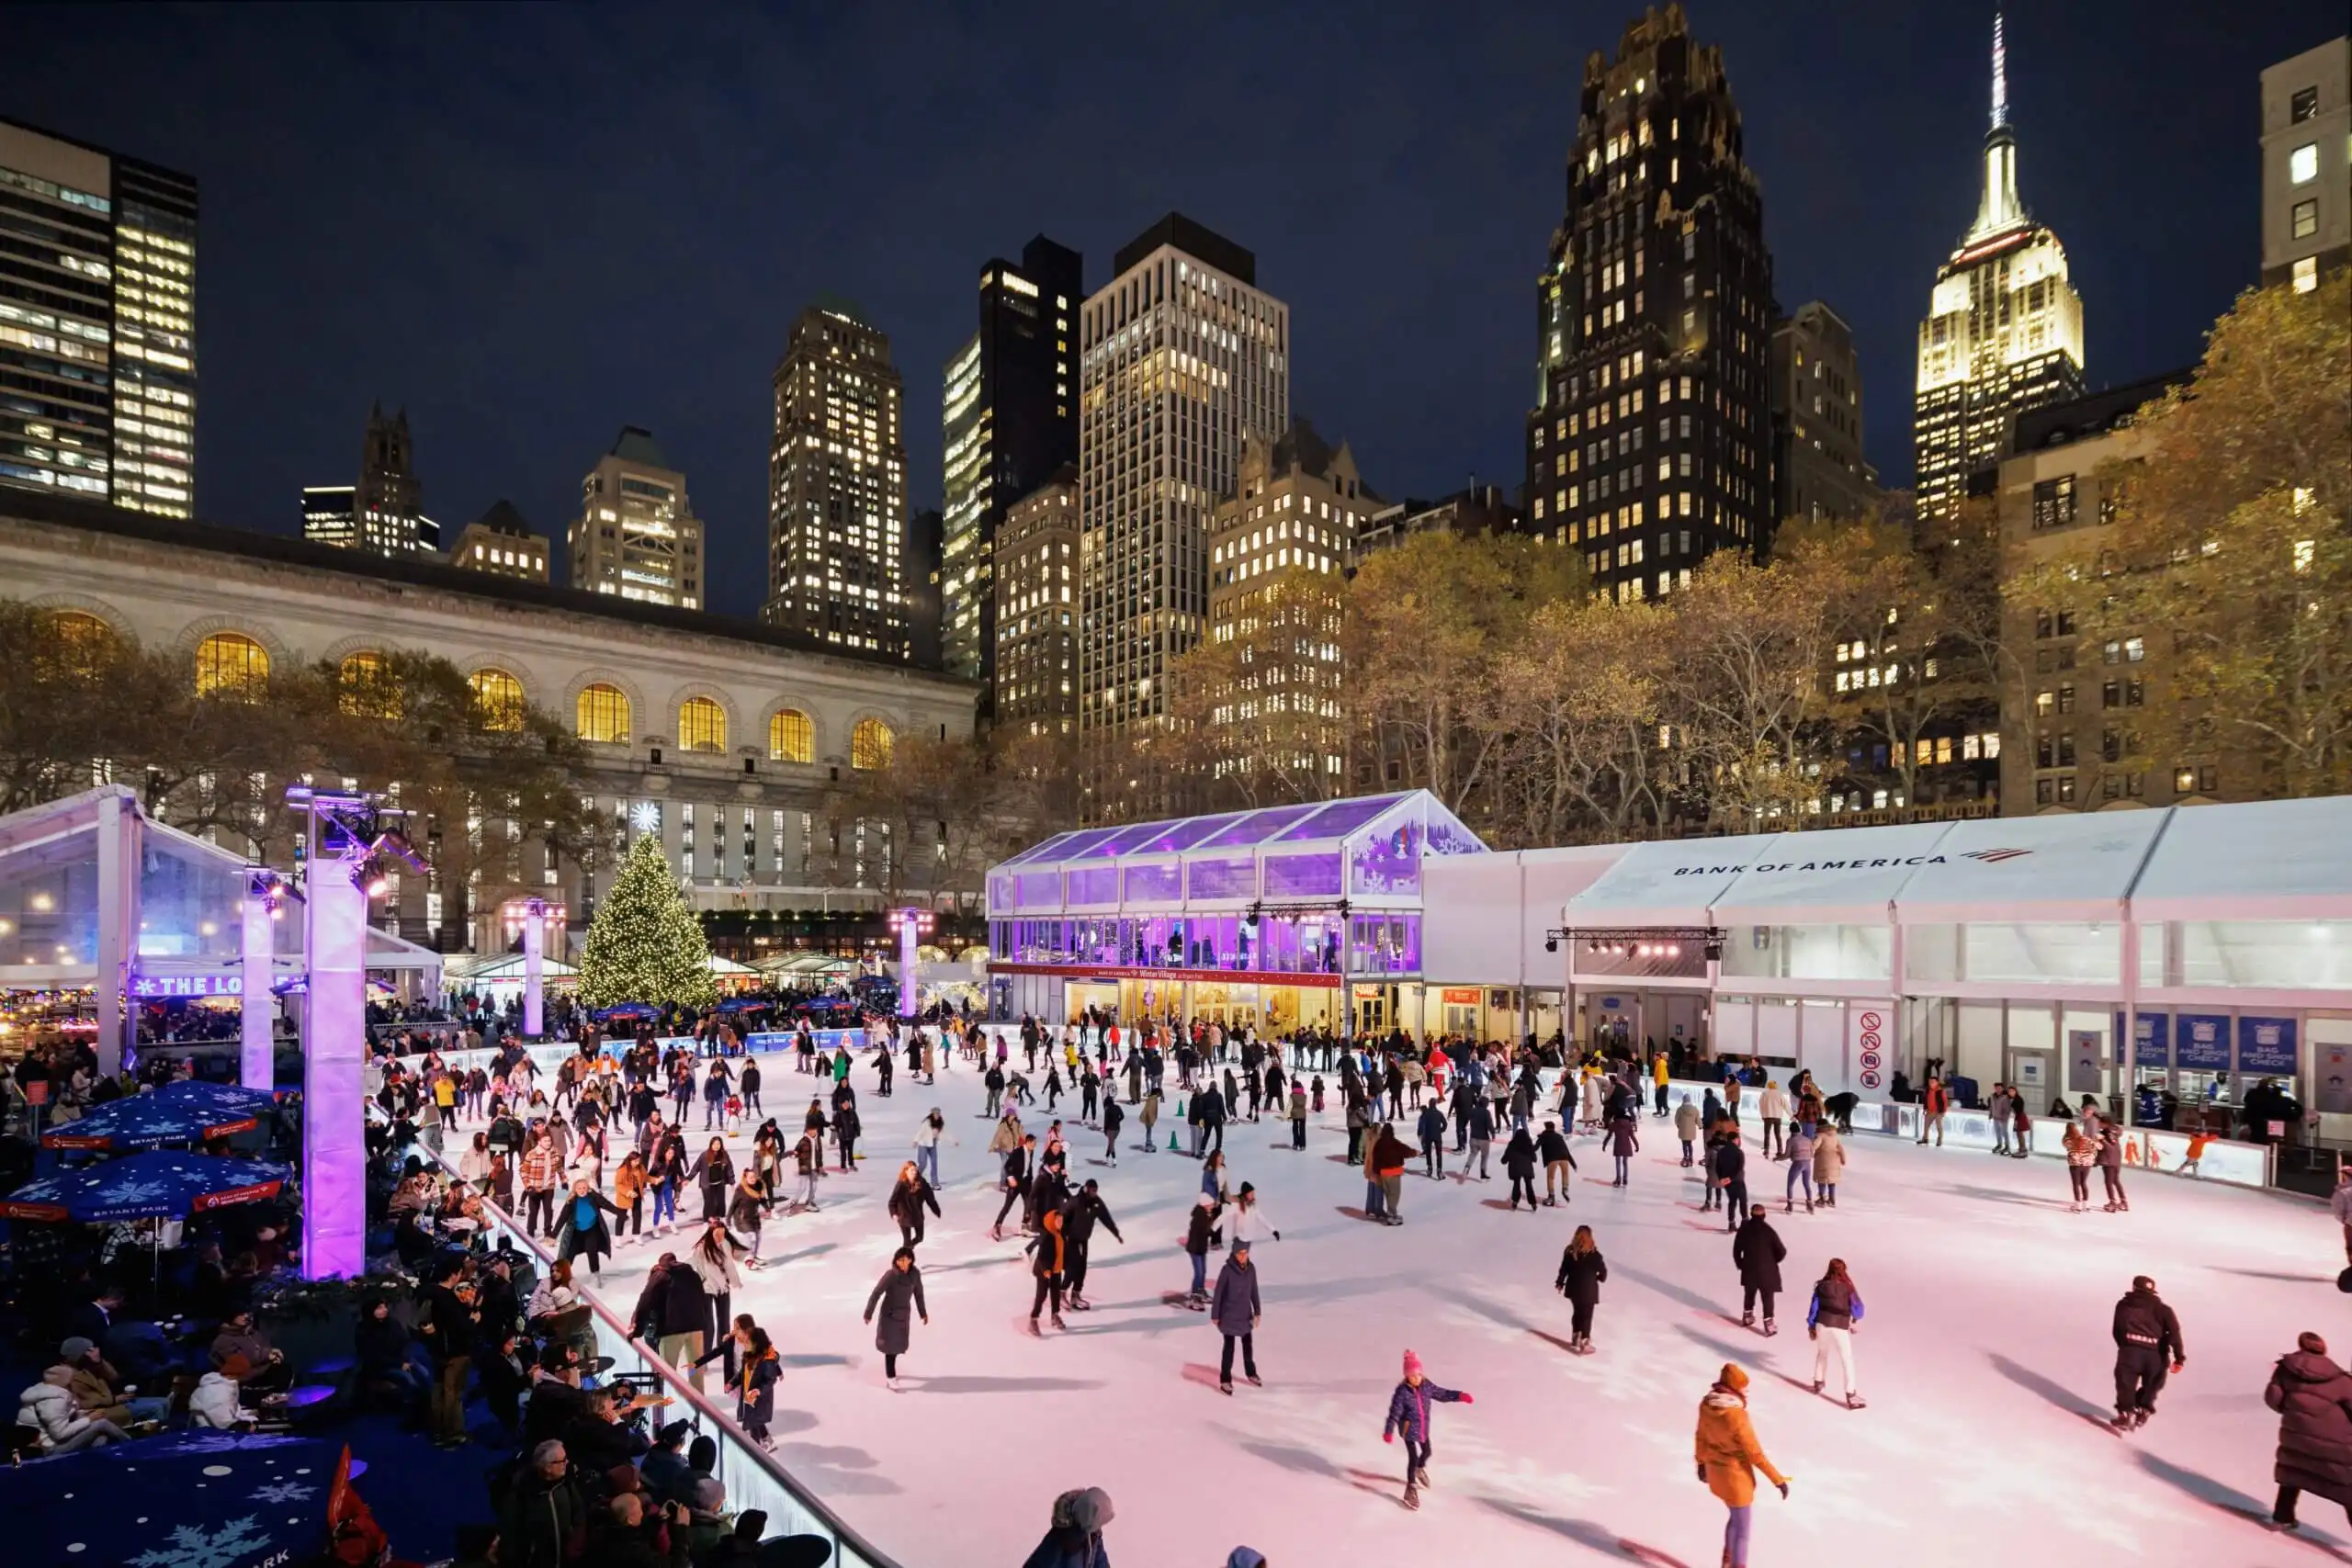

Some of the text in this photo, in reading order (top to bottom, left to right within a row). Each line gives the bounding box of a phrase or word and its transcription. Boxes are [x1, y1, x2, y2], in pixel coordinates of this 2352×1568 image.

[1673, 855, 1948, 876] BANK OF AMERICA
[1139, 969, 1158, 978] Winter
[1158, 969, 1177, 981] Village
[159, 976, 207, 994] THE
[2187, 1055, 2221, 1063] CHECK
[2202, 1049, 2230, 1057] SHOE
[2267, 1053, 2294, 1061] SHOE
[2249, 1058, 2285, 1066] CHECK
[94, 1205, 170, 1217] BRYANT PARK
[252, 1548, 290, 1568] RK
